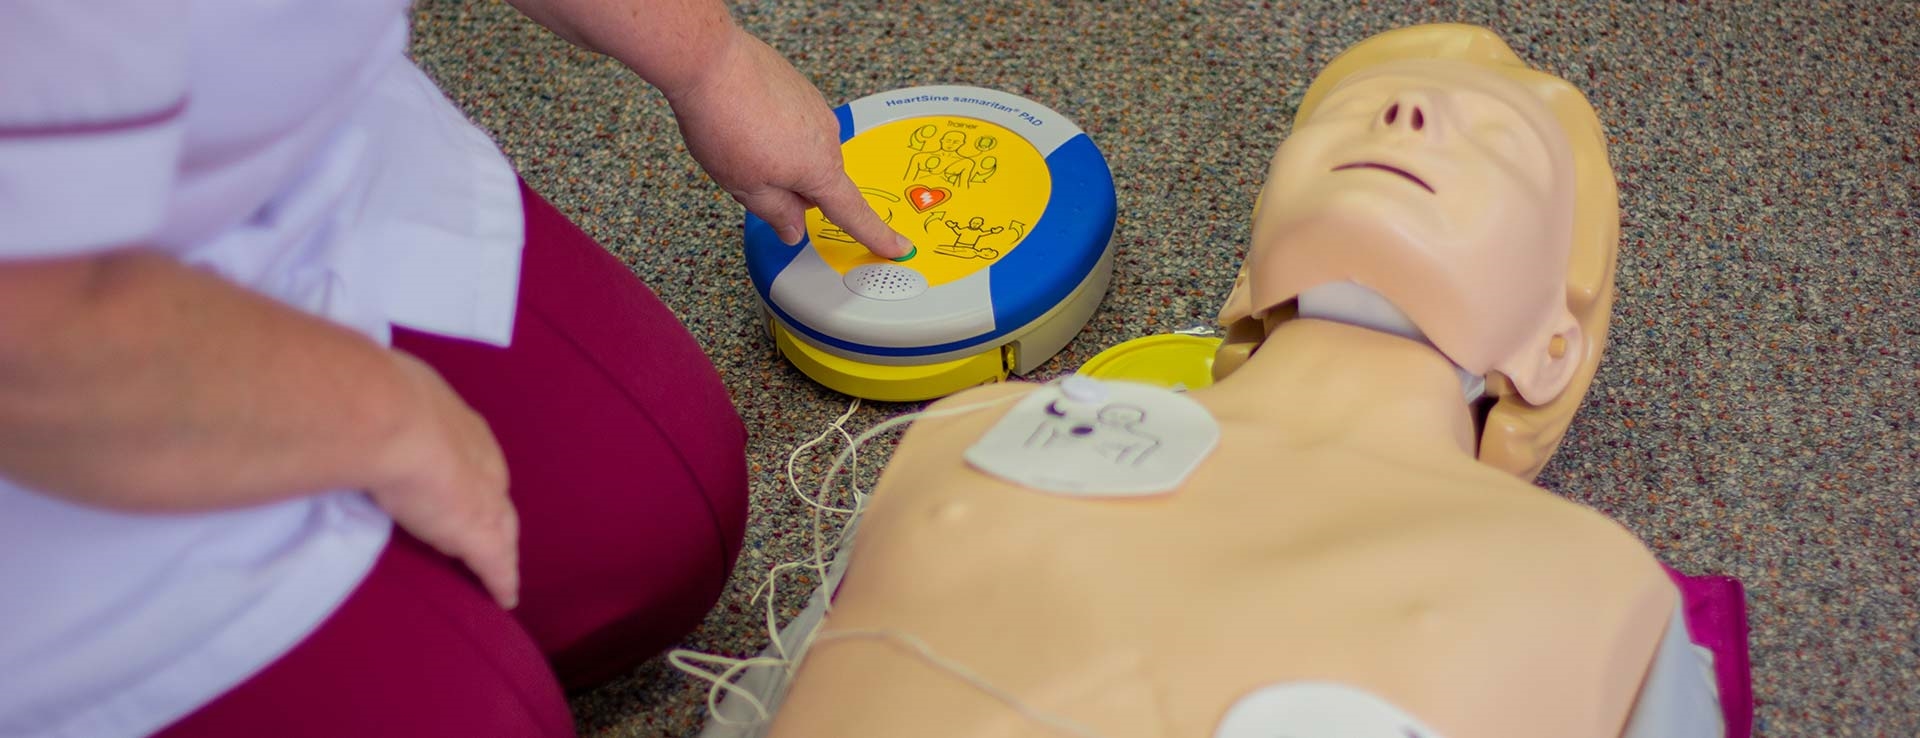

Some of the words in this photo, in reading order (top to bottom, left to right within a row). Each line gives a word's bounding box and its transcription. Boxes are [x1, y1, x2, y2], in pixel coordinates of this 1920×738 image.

[886, 95, 949, 107] HeartSine
[1018, 112, 1043, 127] PAD
[947, 120, 978, 130] Trainer
